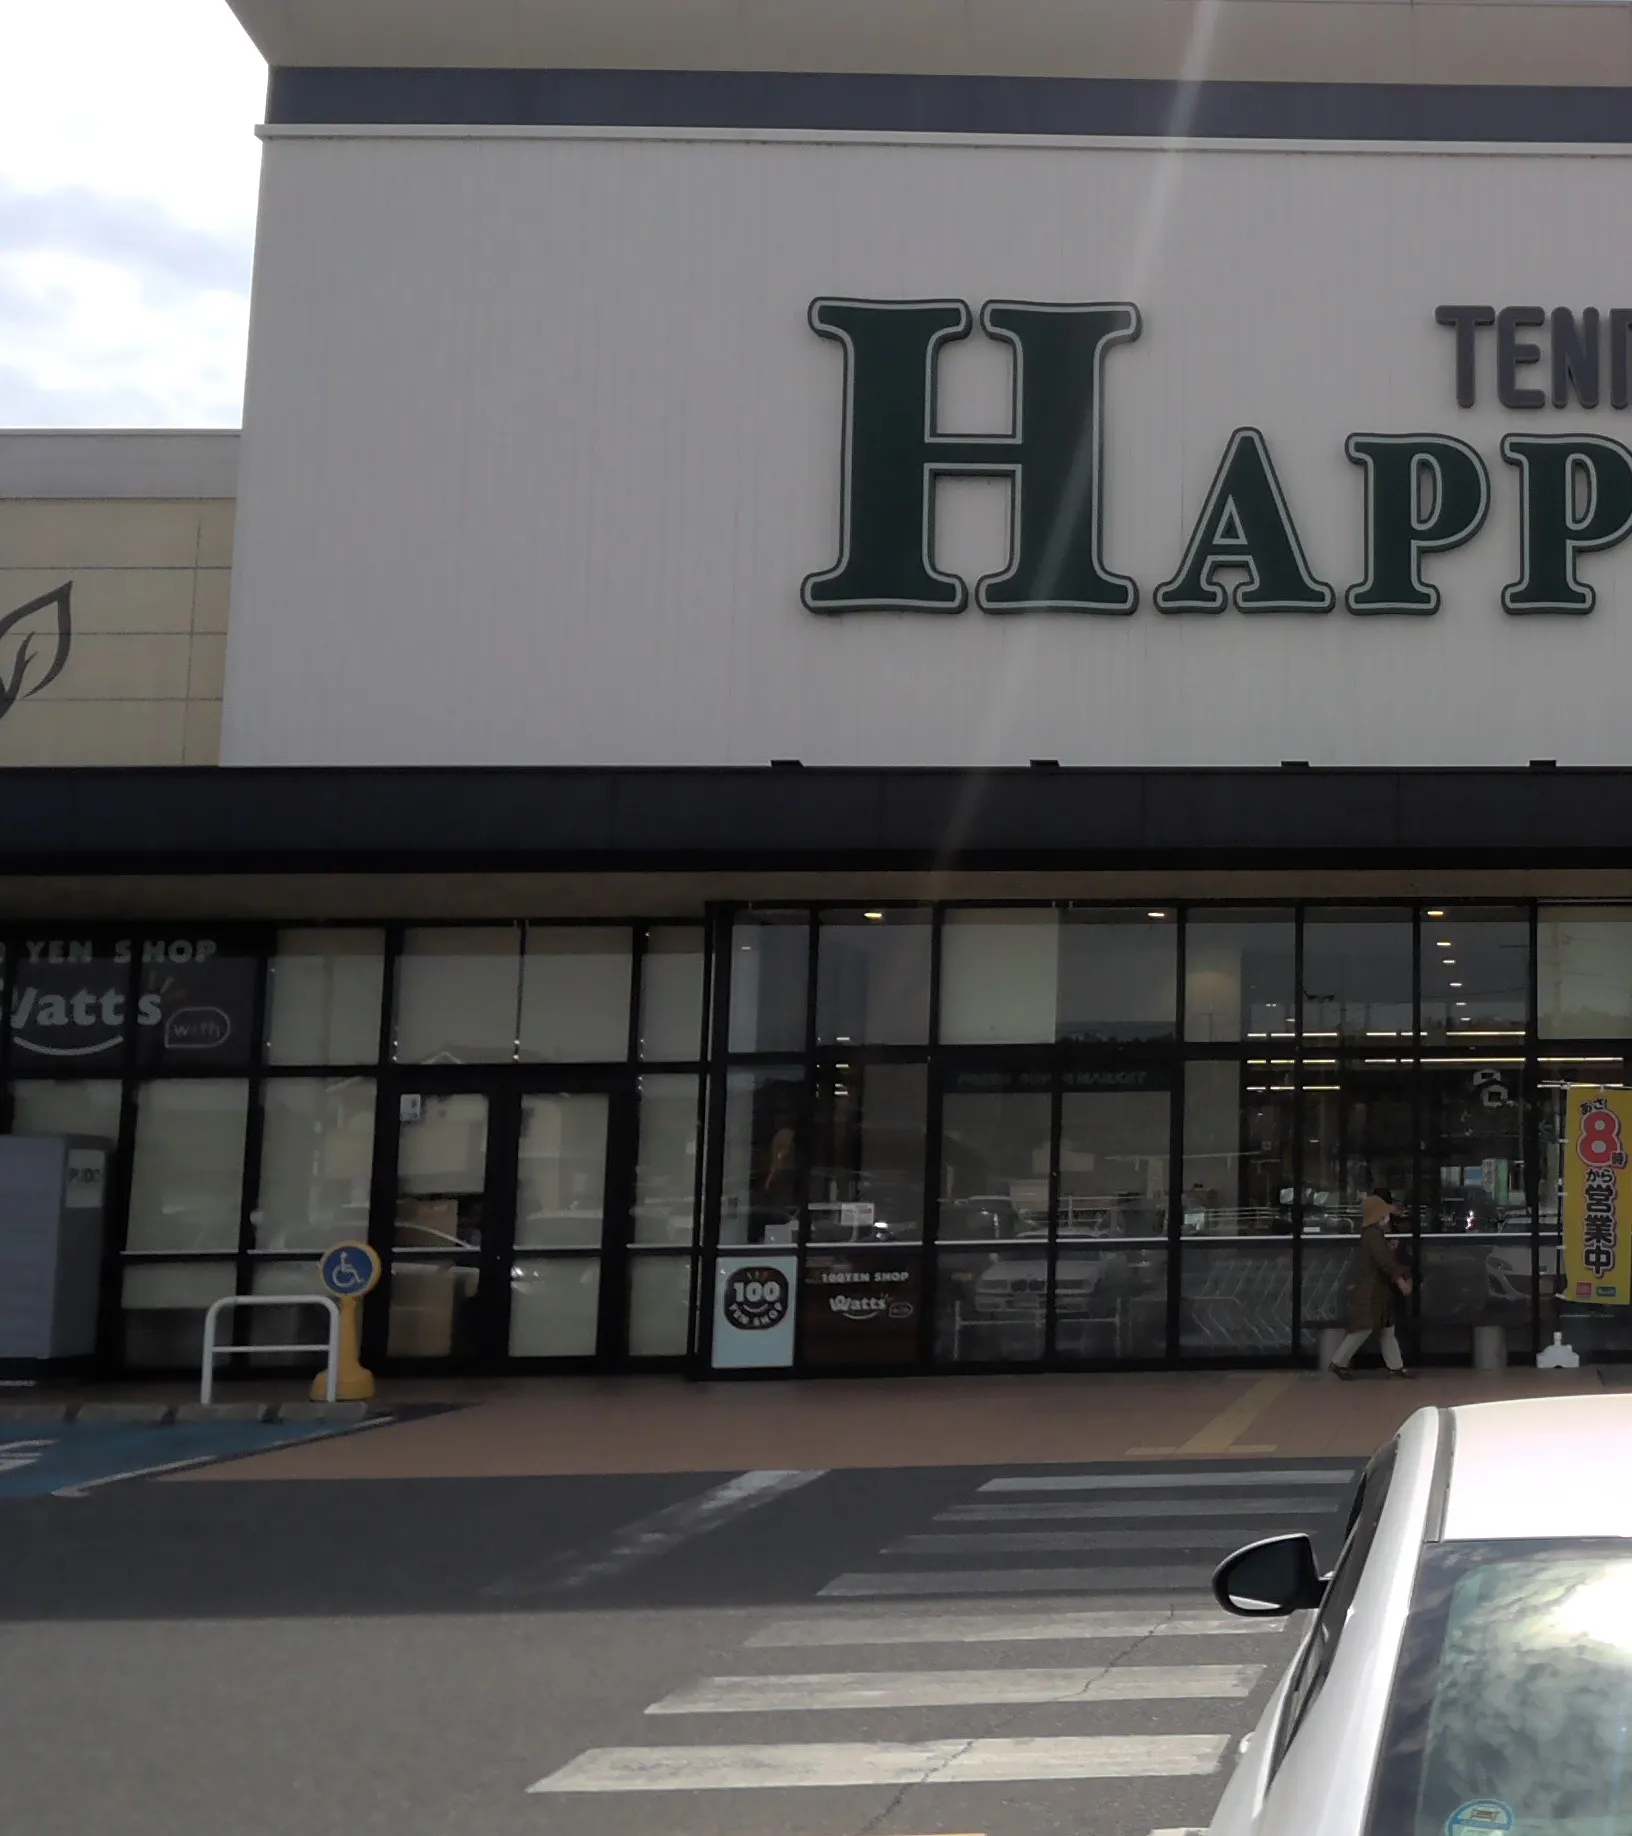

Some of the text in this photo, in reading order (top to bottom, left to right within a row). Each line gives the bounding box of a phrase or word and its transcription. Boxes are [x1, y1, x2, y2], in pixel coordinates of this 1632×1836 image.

[26, 940, 93, 964] YEN
[113, 939, 217, 964] SHOP
[1586, 1168, 1613, 1184] から
[1584, 1184, 1613, 1275] 営業中
[874, 1271, 910, 1283] SHOP
[733, 1281, 781, 1303] 100
